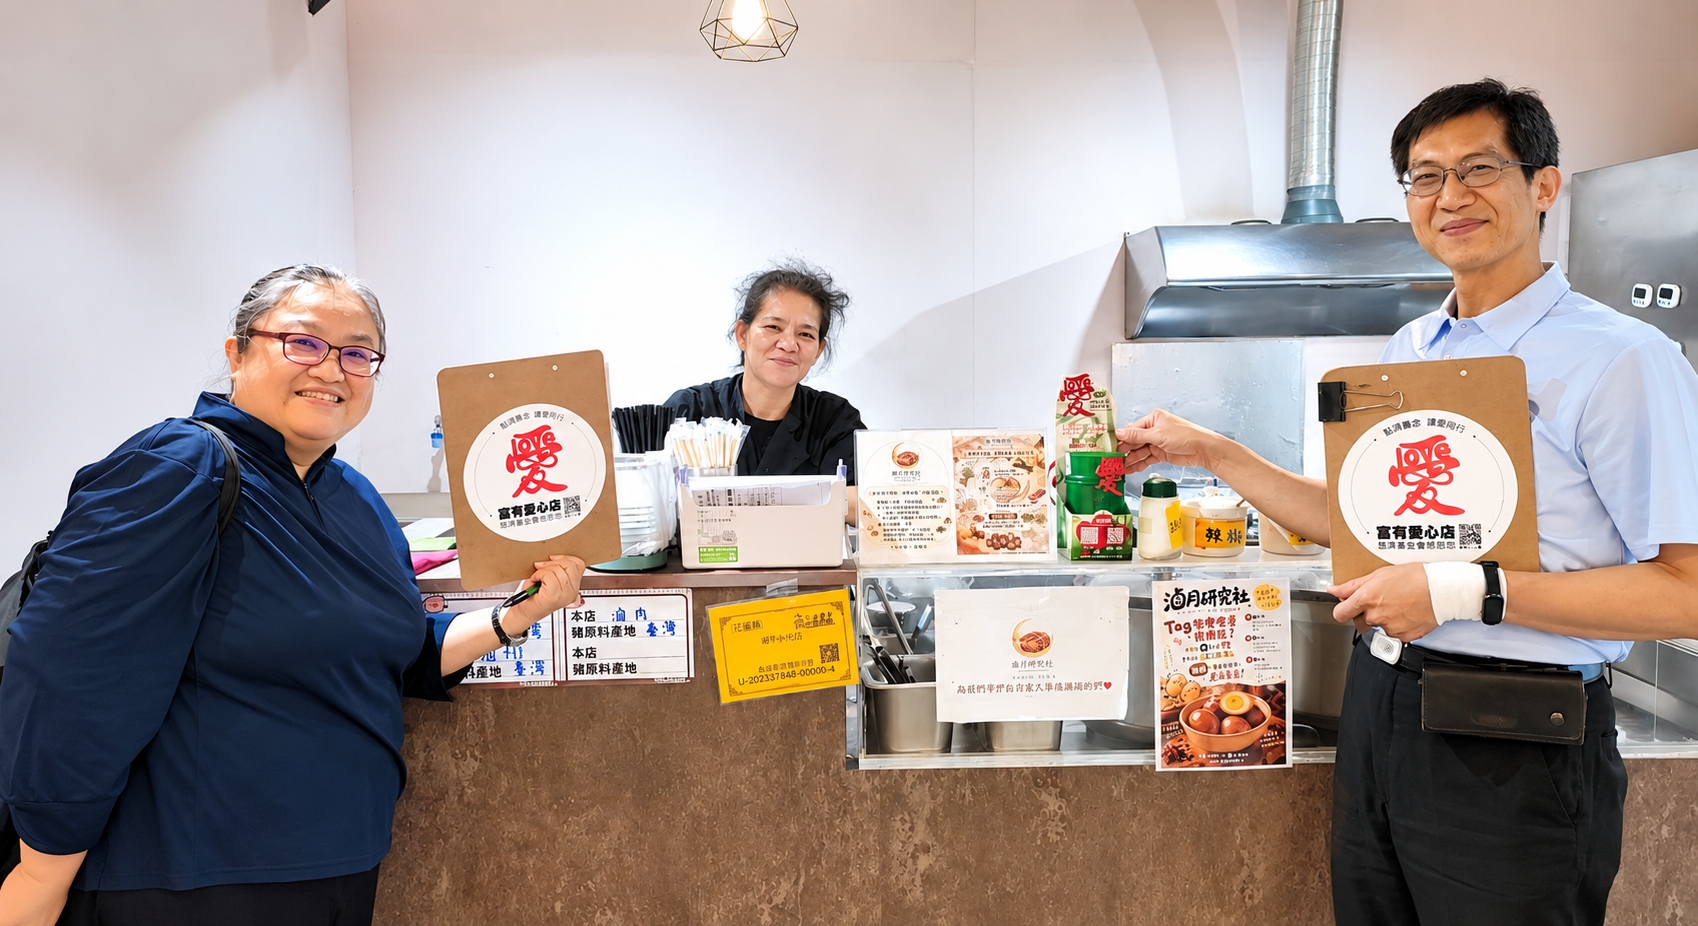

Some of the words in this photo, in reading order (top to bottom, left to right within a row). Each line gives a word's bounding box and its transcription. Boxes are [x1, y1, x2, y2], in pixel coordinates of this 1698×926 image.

[498, 499, 561, 520] 富有愛心店
[1376, 525, 1455, 540] 富有愛心店
[1163, 586, 1250, 612] 滷月研究社
[571, 610, 596, 622] 本店
[571, 624, 636, 638] 豬原料產地
[1164, 620, 1192, 634] Tag
[572, 646, 597, 659] 本店
[572, 662, 637, 676] 豬原料產地
